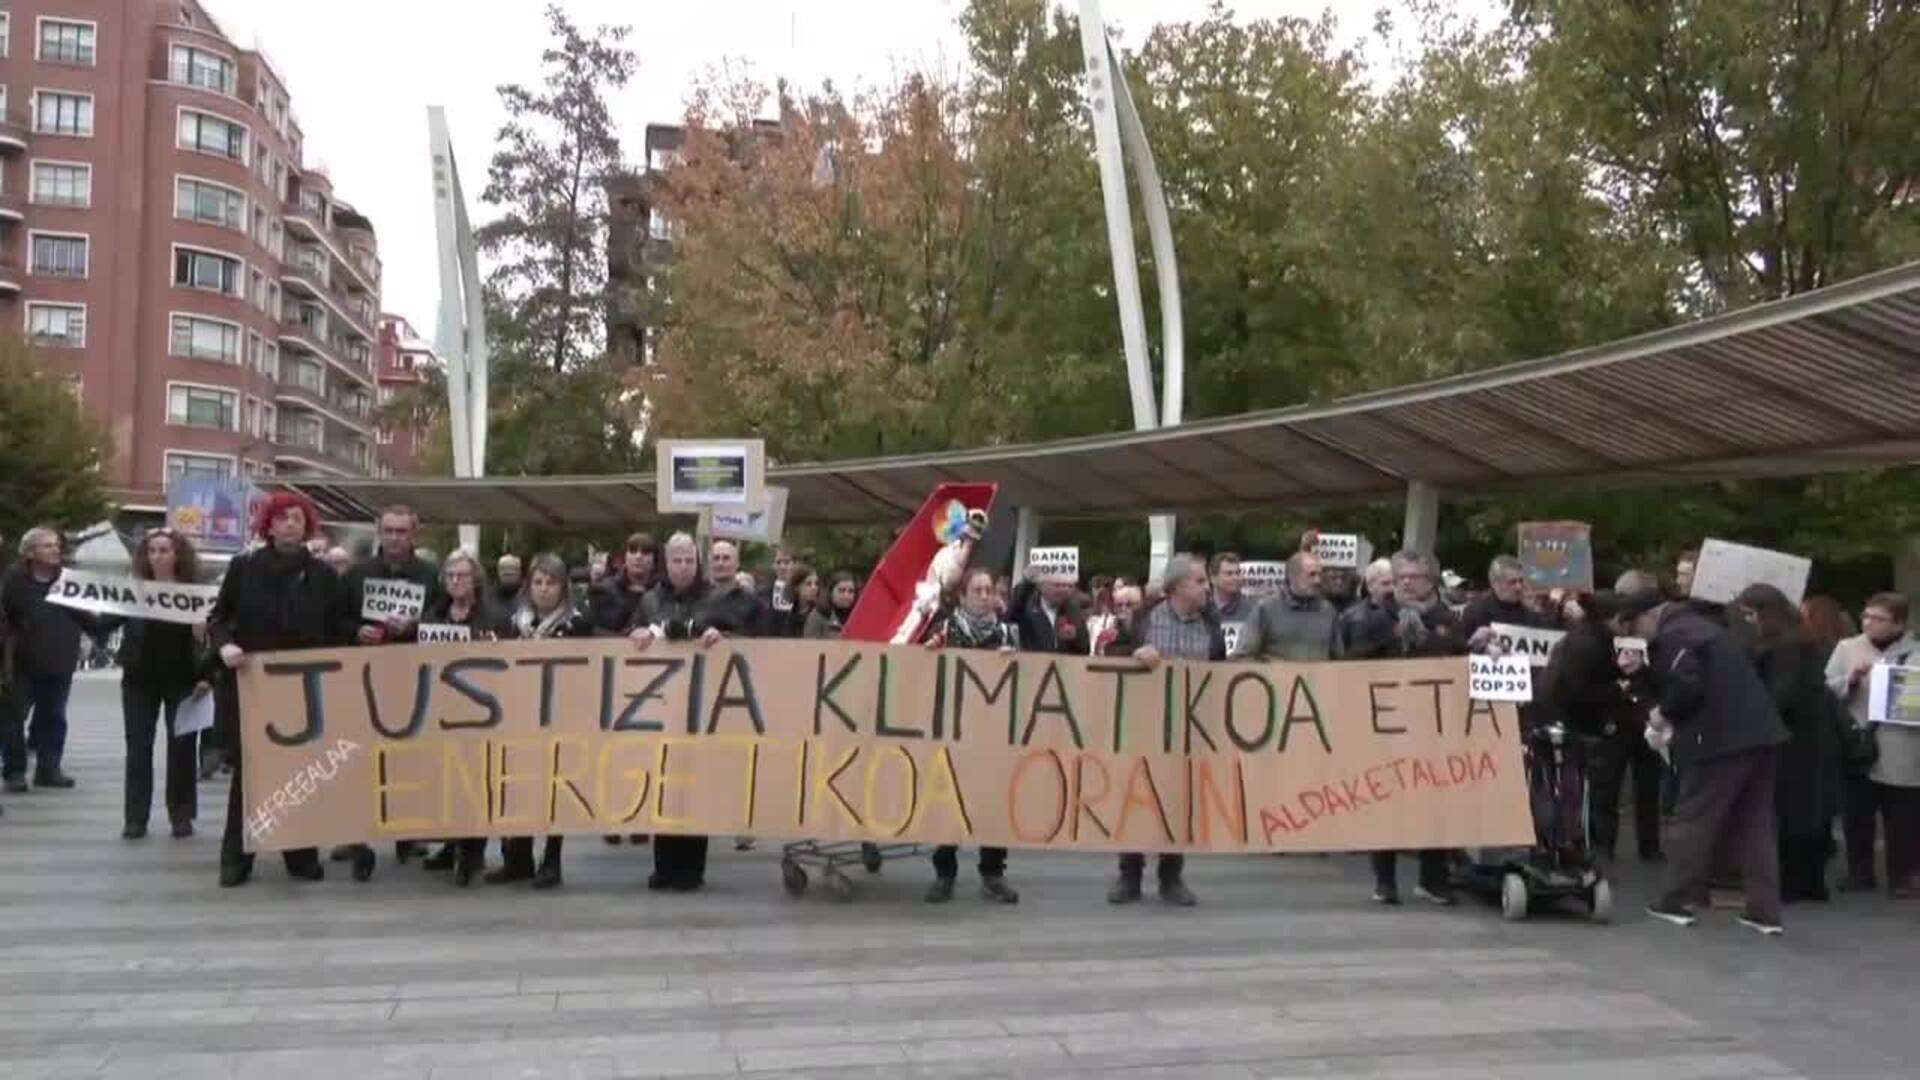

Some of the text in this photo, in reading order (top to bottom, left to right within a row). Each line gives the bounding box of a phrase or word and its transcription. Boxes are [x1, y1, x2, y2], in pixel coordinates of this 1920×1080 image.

[1041, 564, 1076, 575] OP29
[63, 581, 138, 605] DANA
[1471, 660, 1527, 676] DANA+
[1472, 679, 1527, 692] COP29
[263, 650, 1502, 754] JUSTIZIA KLIMATIKOA ETA
[372, 735, 1249, 845] ENERGETIKOA ORAIN
[1258, 750, 1499, 844] ALDAKETALDIA
